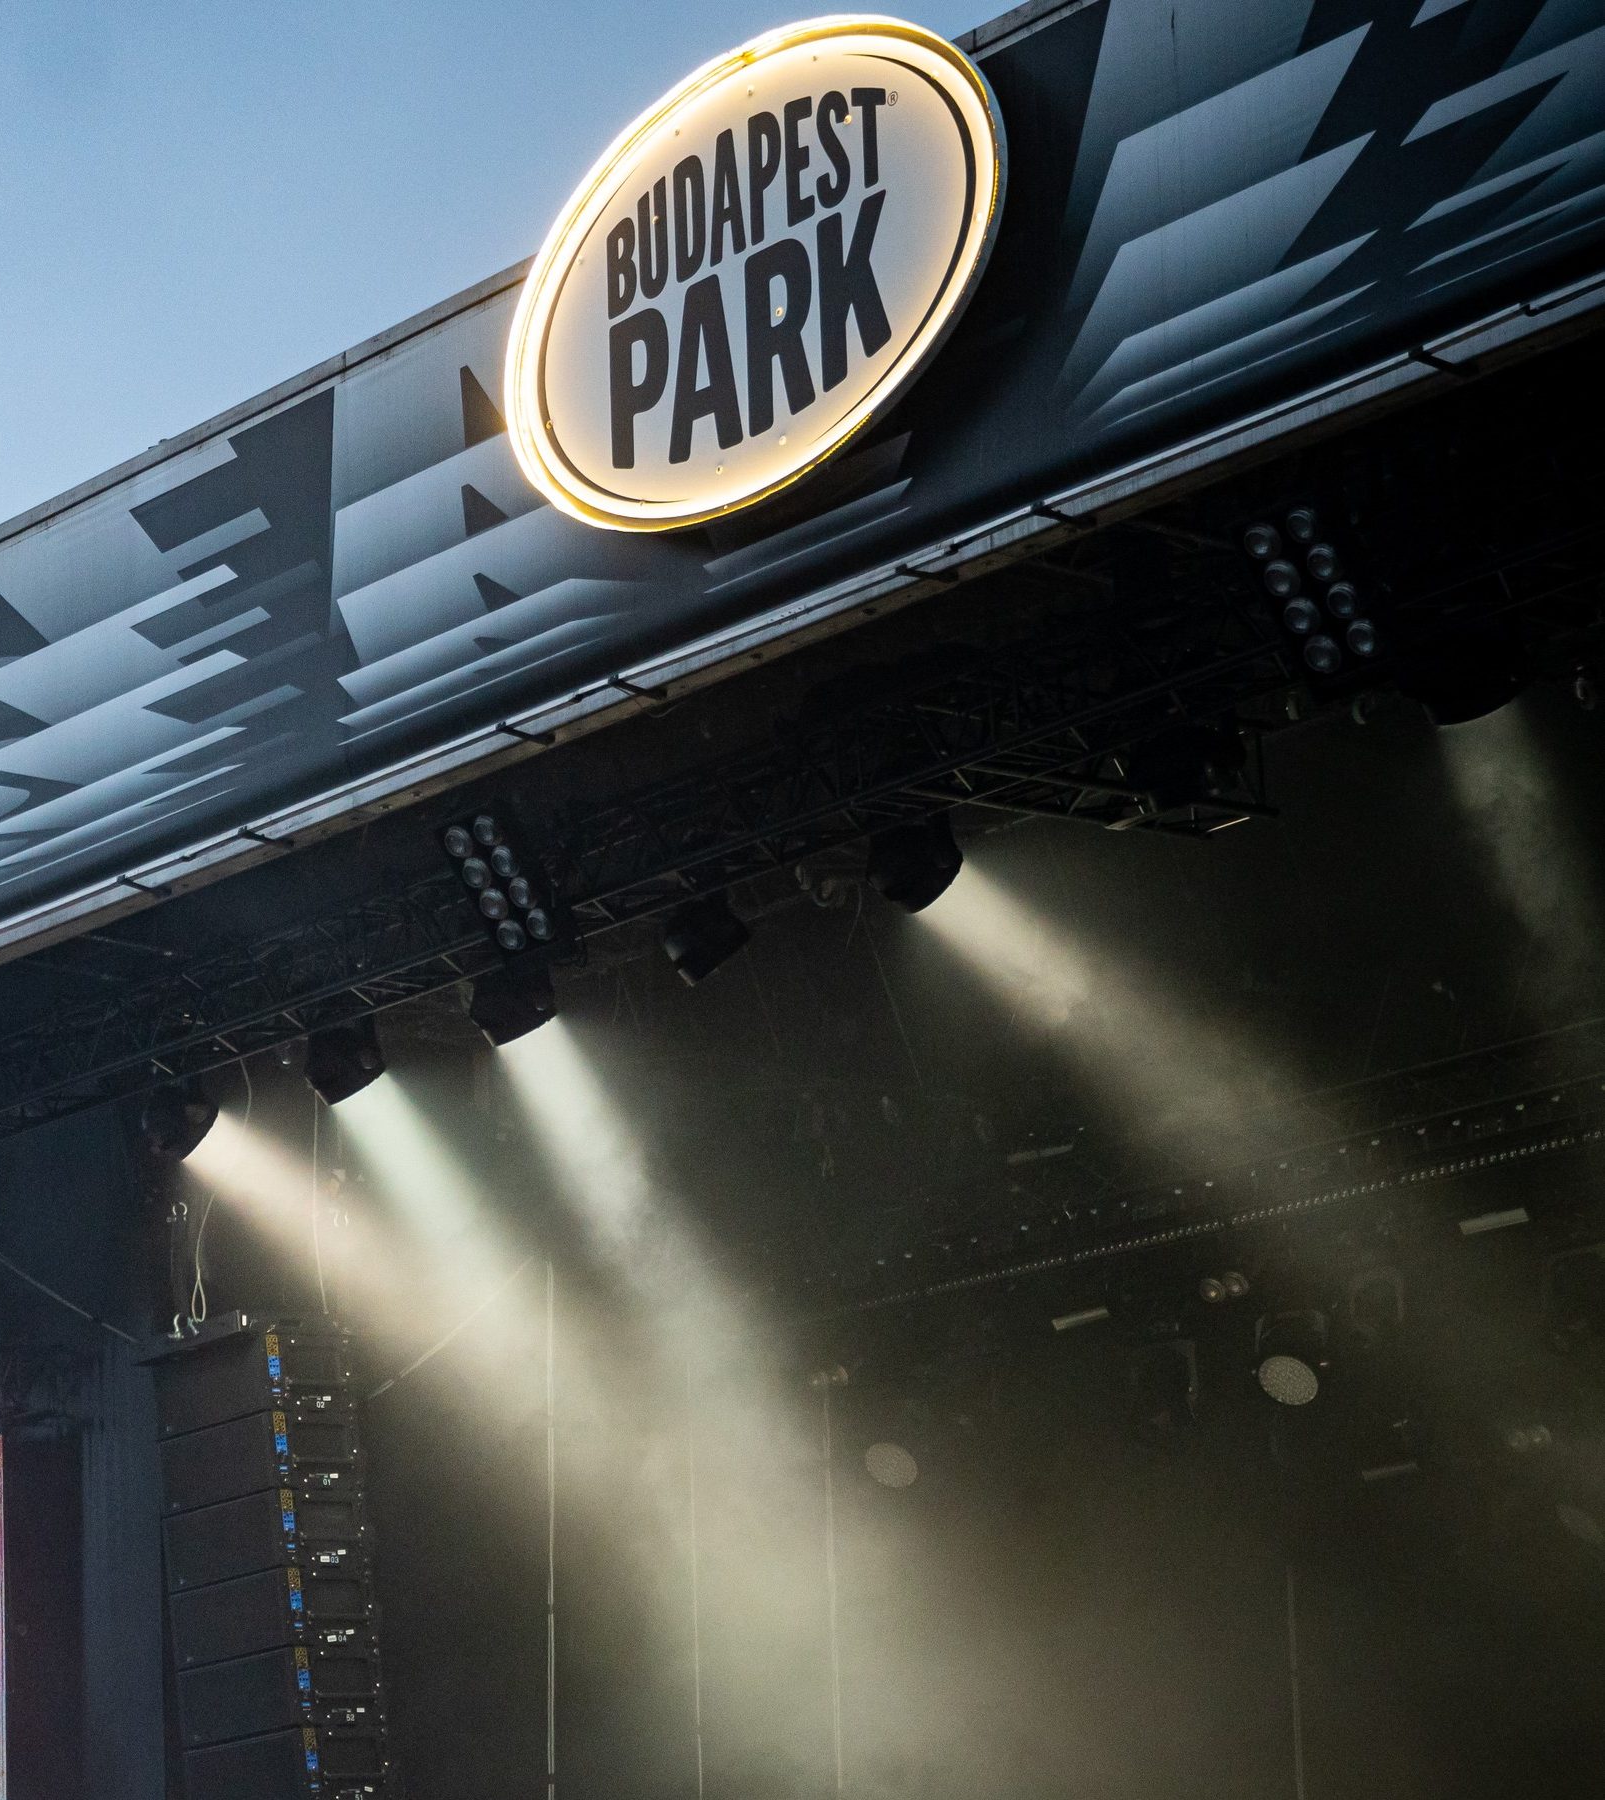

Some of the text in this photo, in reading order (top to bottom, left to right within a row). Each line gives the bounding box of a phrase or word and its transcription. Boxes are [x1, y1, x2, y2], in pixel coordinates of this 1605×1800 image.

[608, 189, 892, 469] PARK
[322, 1478, 331, 1486] 01
[330, 1556, 339, 1564] 03
[338, 1635, 347, 1643] 04
